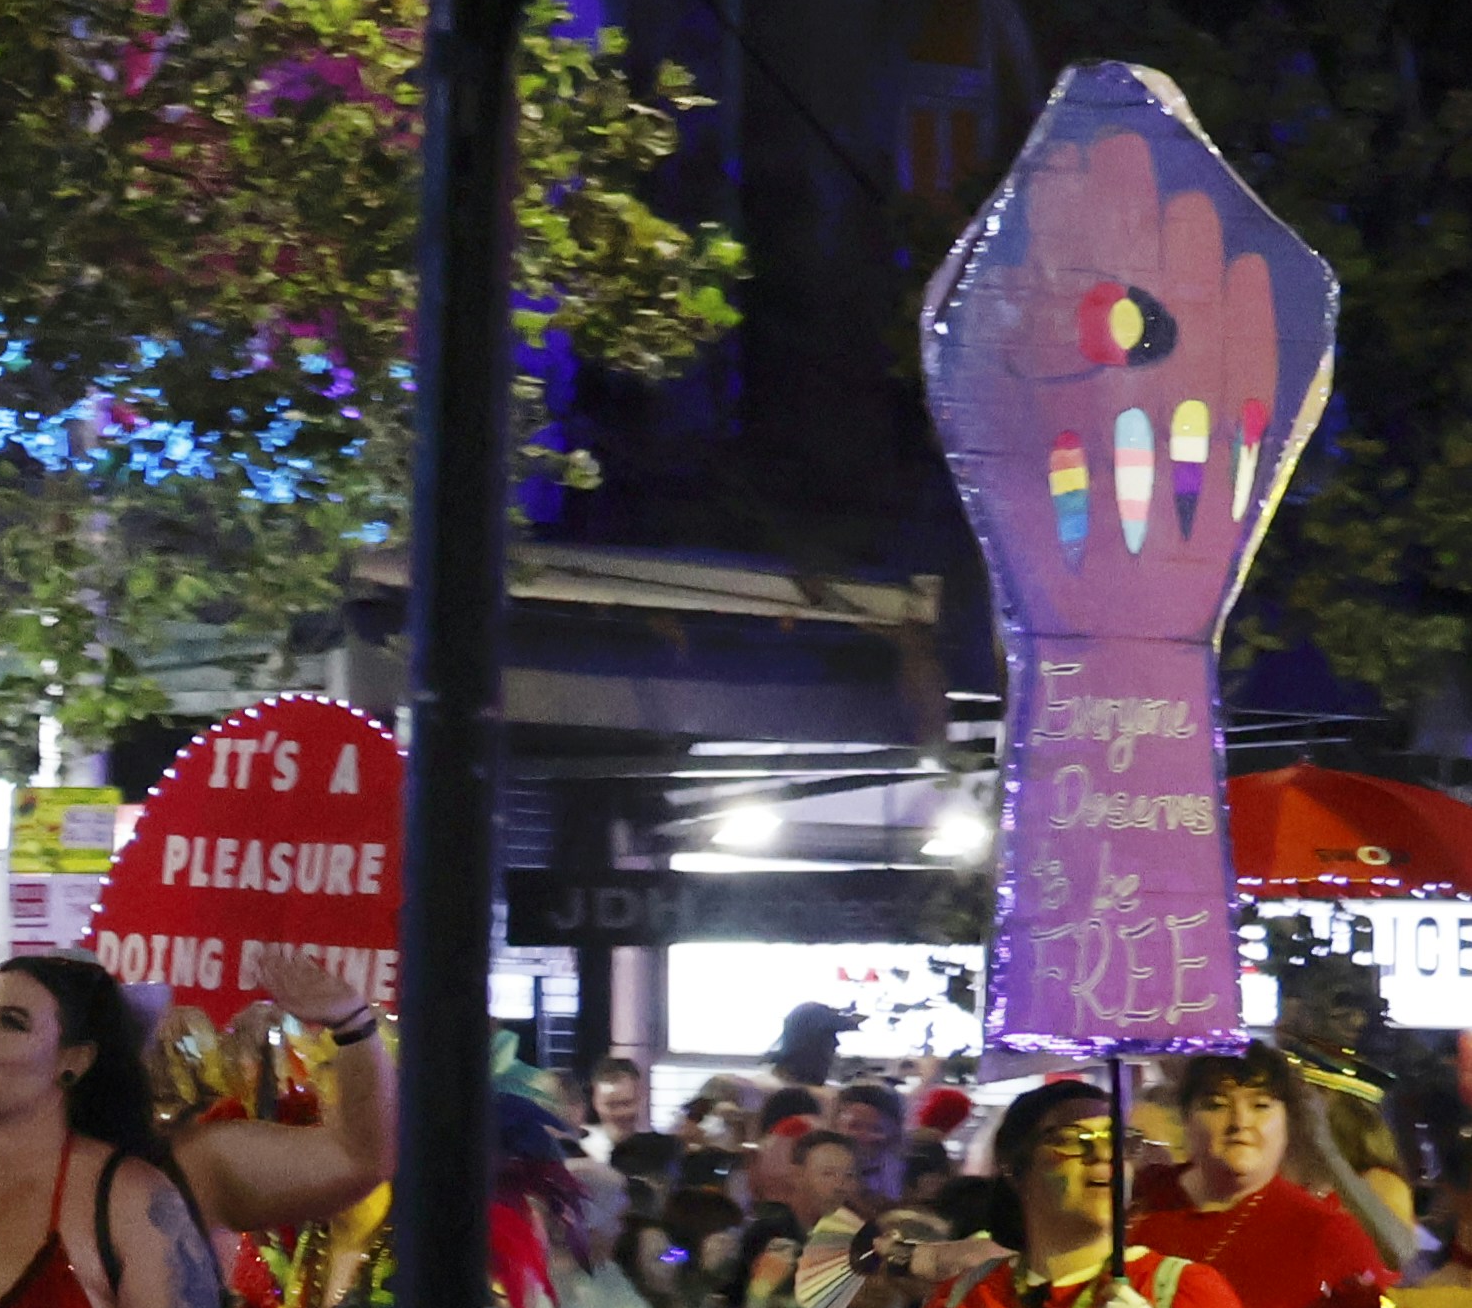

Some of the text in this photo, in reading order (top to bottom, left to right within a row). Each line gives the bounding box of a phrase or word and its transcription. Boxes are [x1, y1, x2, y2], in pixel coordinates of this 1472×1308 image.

[207, 730, 360, 795] IT'S A
[161, 833, 387, 896] PLEASURE
[96, 929, 225, 991] DOING
[1029, 910, 1219, 1037] FREE
